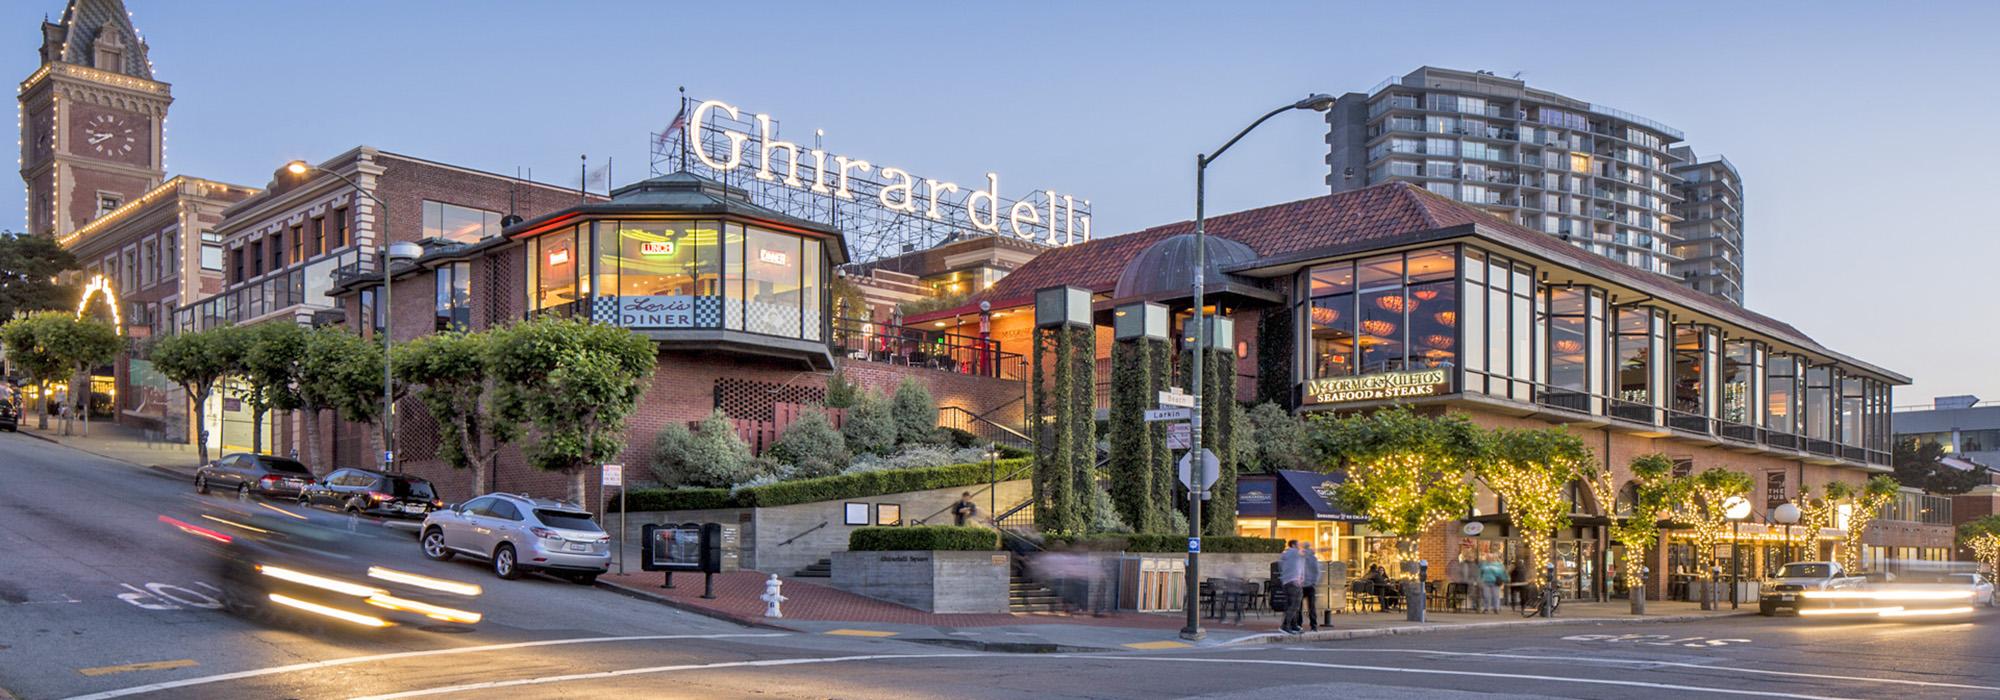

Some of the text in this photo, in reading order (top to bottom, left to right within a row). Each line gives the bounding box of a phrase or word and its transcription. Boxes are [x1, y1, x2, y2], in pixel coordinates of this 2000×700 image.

[689, 99, 1091, 247] Ghirardelli
[642, 242, 672, 253] LUNCH
[623, 297, 691, 313] Lori's
[623, 314, 690, 325] DINER
[1317, 384, 1434, 403] SEAFOOD & STEAKS
